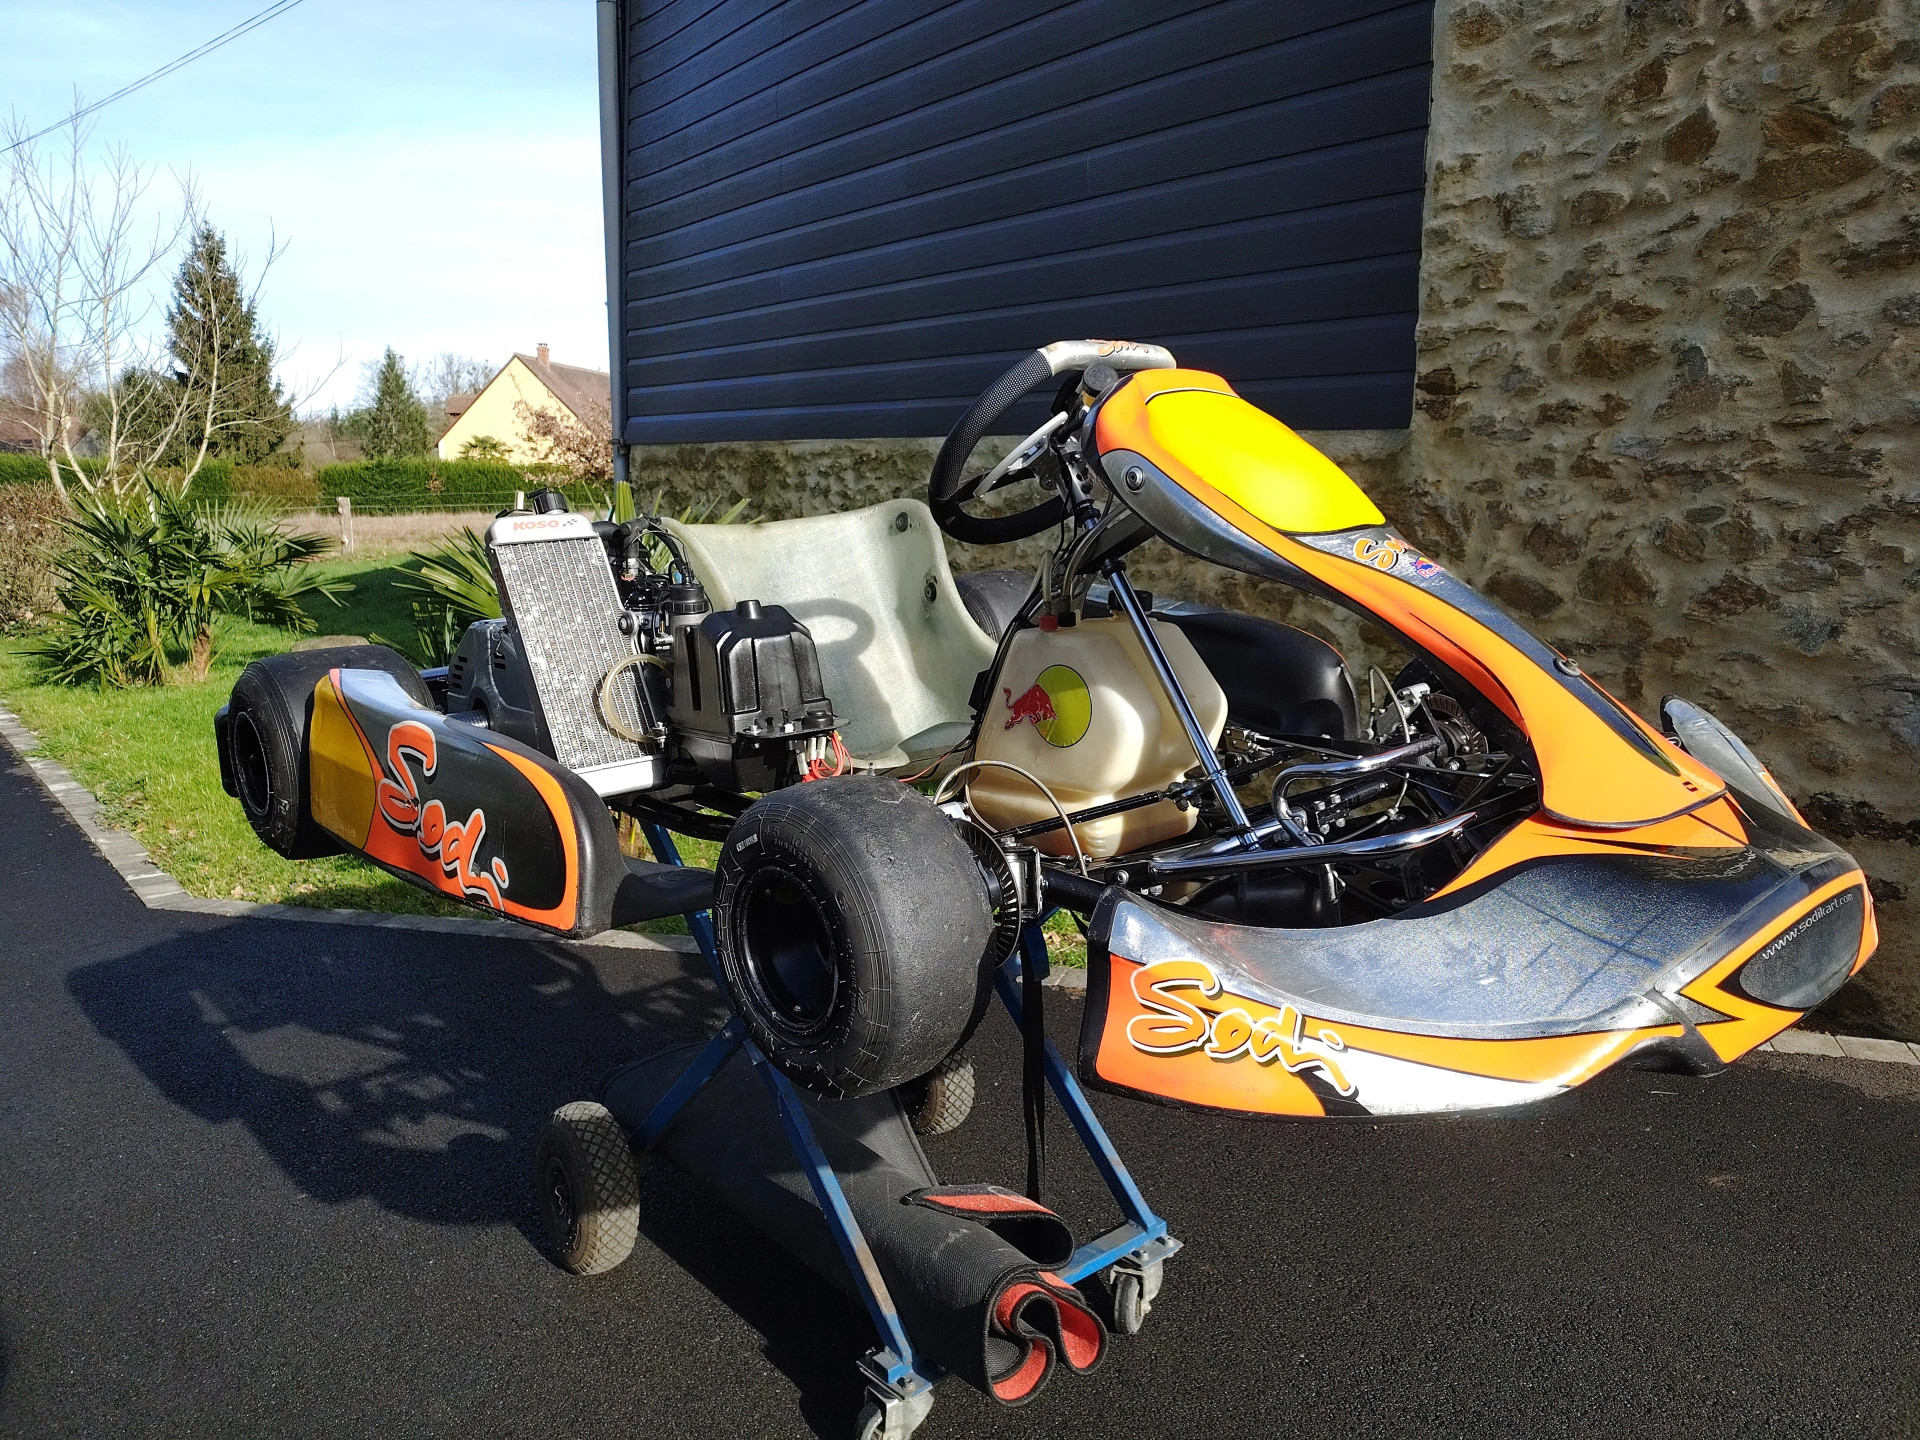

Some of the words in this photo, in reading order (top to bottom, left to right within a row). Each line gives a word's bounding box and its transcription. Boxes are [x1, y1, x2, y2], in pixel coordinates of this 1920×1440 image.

[513, 520, 559, 531] KOSO
[378, 720, 510, 912] Sodi
[1762, 893, 1854, 960] www.sodikart.com
[1126, 957, 1358, 1098] Sodi
